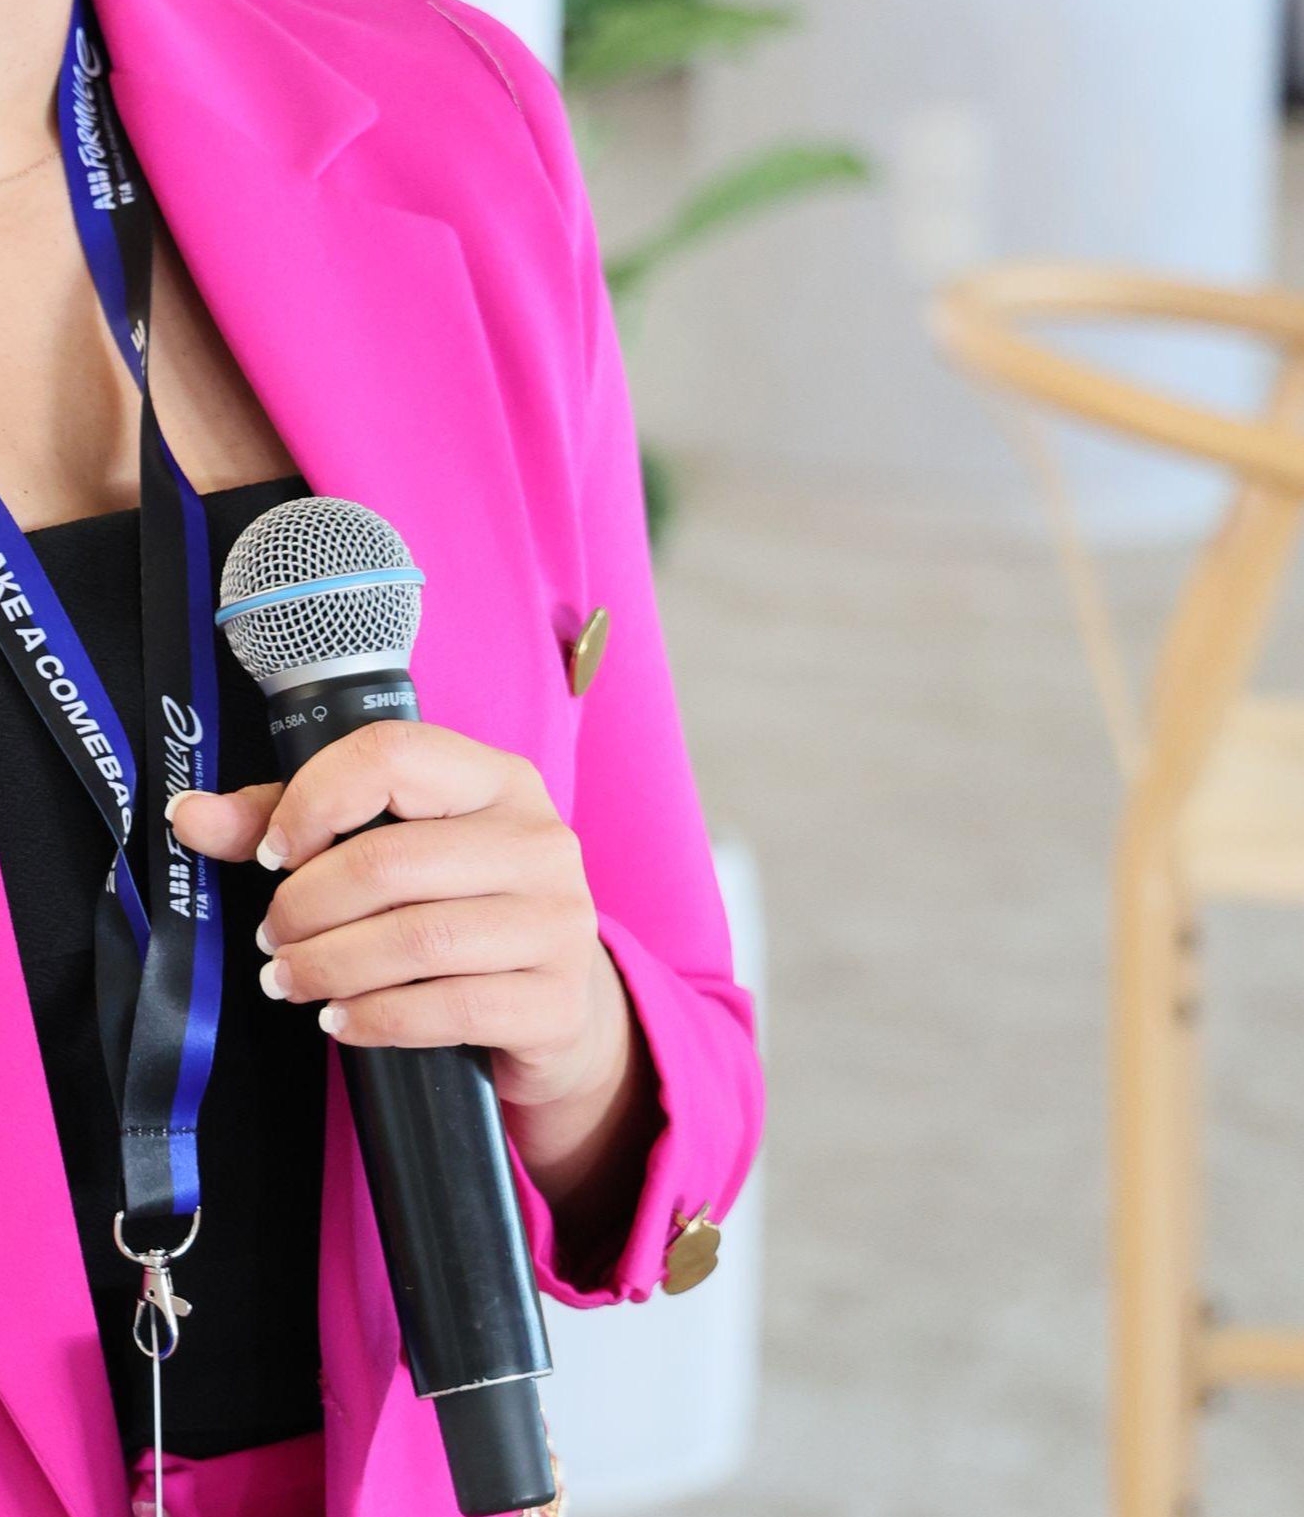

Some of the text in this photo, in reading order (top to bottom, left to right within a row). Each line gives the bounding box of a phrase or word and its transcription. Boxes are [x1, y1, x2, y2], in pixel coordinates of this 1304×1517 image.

[87, 170, 117, 210] ABB
[118, 181, 136, 205] FIA
[362, 691, 417, 710] SHURE
[15, 627, 47, 653] A
[35, 654, 132, 845] COMEBAC
[270, 713, 307, 735] ETA 58A
[164, 735, 193, 863] FMULA
[198, 855, 207, 886] WORL
[169, 863, 191, 918] ABB
[196, 892, 209, 921] FIA
